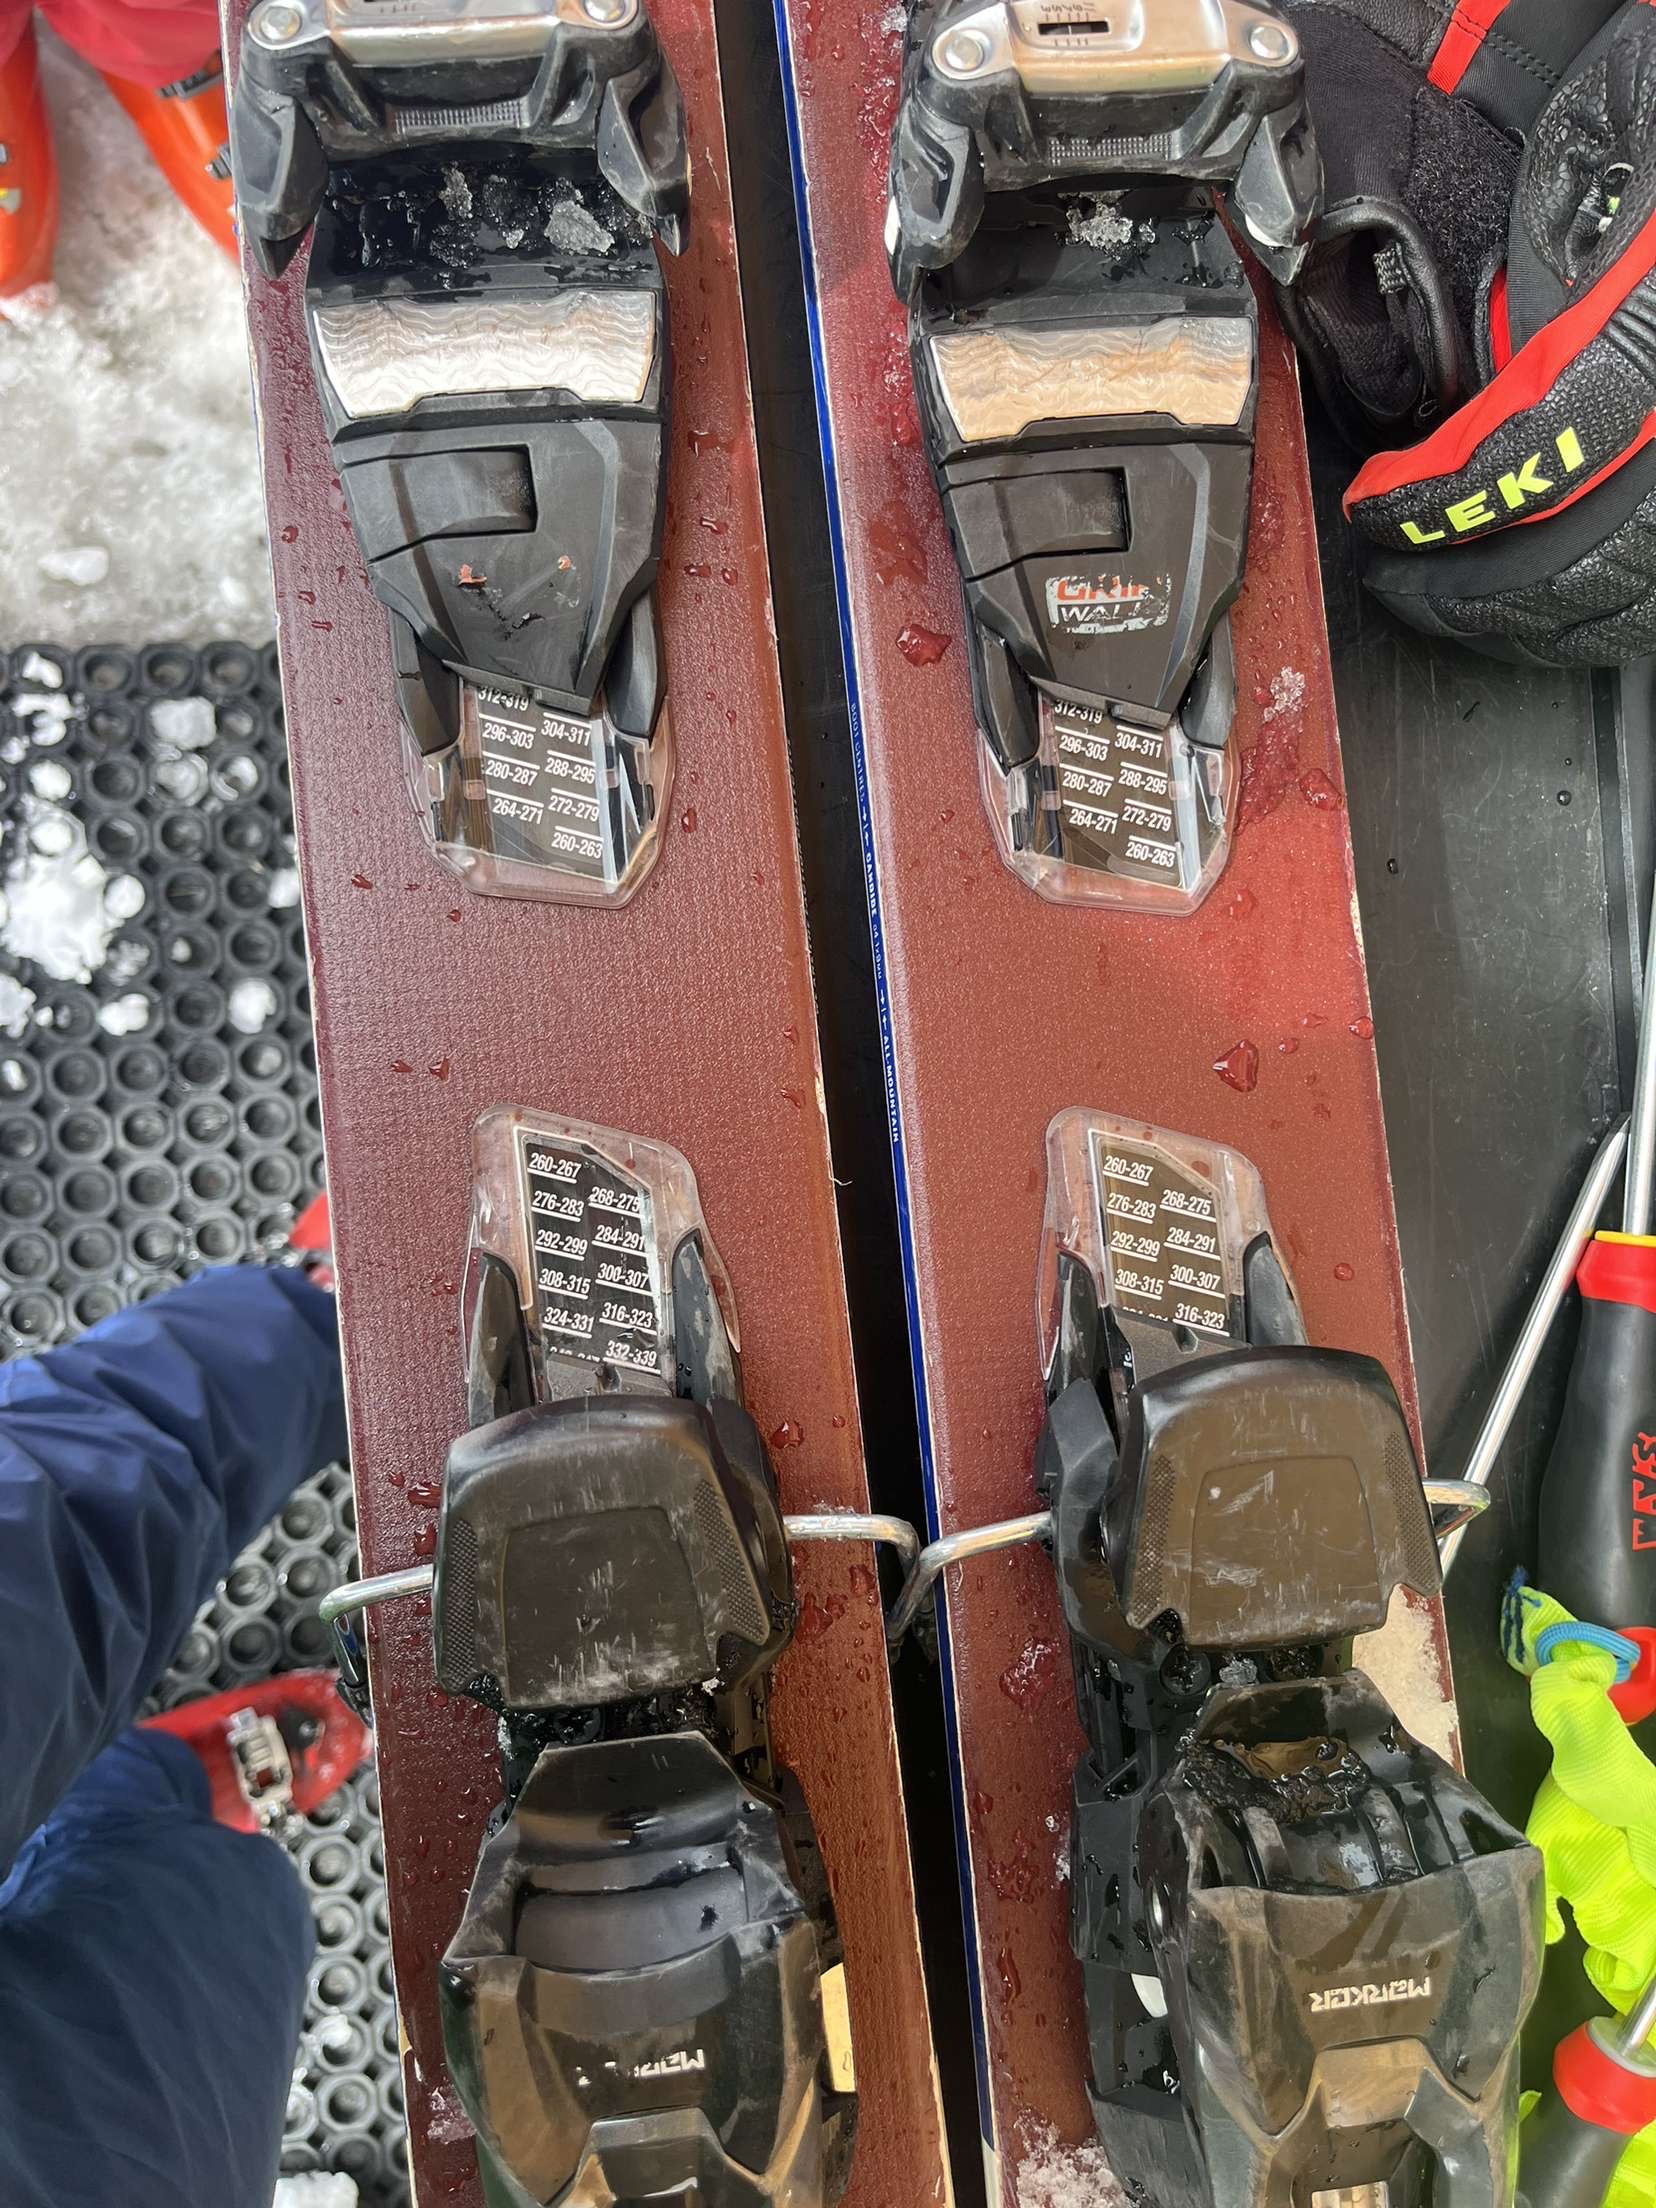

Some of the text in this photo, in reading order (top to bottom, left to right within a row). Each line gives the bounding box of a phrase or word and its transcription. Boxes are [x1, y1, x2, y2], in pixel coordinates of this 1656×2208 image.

[1400, 426, 1585, 544] LEKI
[850, 703, 859, 738] BOOT
[1055, 701, 1103, 724] 312-319
[483, 722, 534, 749] 296-303
[541, 720, 591, 746] 304-311
[1115, 732, 1162, 758] 304-311
[1059, 735, 1109, 761] 296-303
[486, 760, 537, 787] 280-287
[545, 758, 596, 784] 288-295
[1119, 769, 1167, 795] 288-295
[1062, 771, 1112, 798] 280-287
[493, 798, 543, 824] 264-271
[549, 796, 599, 822] 272-279
[1069, 809, 1118, 834] 264-271
[1122, 806, 1171, 832] 272-279
[552, 832, 602, 859] 260-263
[1126, 842, 1175, 867] 260-263
[865, 852, 878, 917] CANDIDE
[884, 1035, 899, 1143] ALL-MOUNTAIN
[529, 1152, 581, 1179] 260-267
[1104, 1155, 1153, 1181] 260-267
[533, 1191, 584, 1217] 276-283
[590, 1187, 640, 1212] 268-275
[1107, 1193, 1156, 1219] 276-283
[1161, 1189, 1212, 1215] 268-275
[536, 1230, 588, 1256] 292-299
[595, 1225, 645, 1251] 284-291
[1111, 1231, 1160, 1256] 292-299
[1167, 1227, 1216, 1253] 284-291
[540, 1269, 591, 1295] 308-315
[598, 1263, 649, 1289] 300-307
[1115, 1269, 1164, 1295] 308-315
[1170, 1264, 1221, 1290] 300-307
[544, 1307, 594, 1333] 324-331
[602, 1303, 652, 1327] 316-323
[1175, 1303, 1225, 1329] 316-323
[606, 1341, 657, 1367] 332-339
[1308, 1976, 1431, 2013] MARKER
